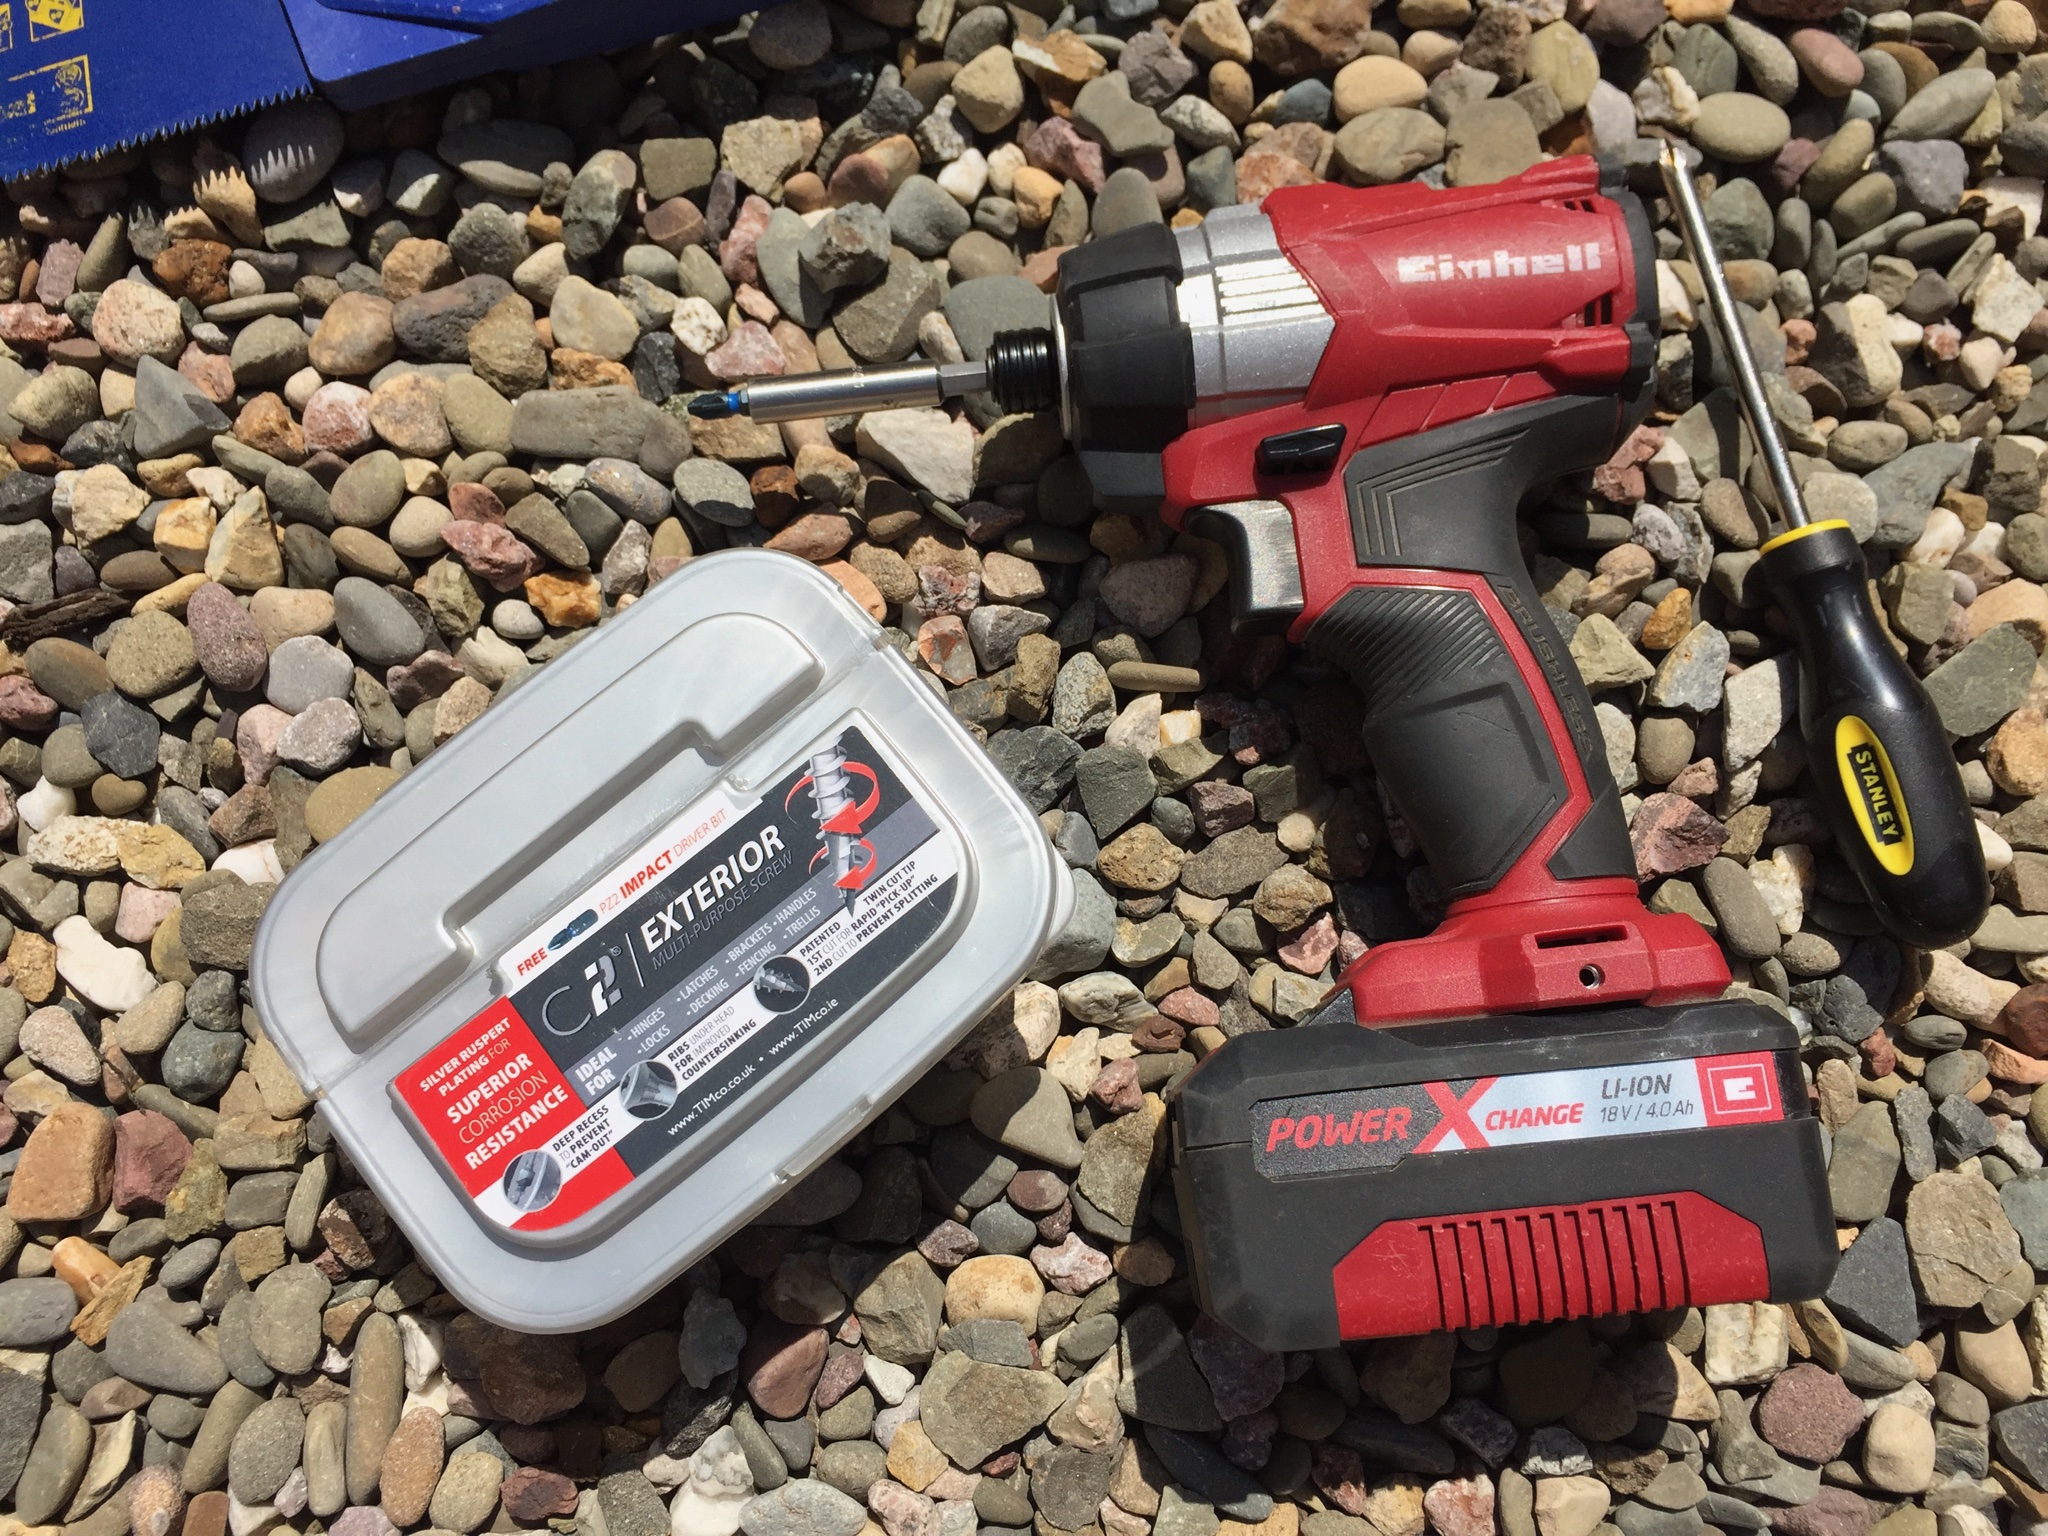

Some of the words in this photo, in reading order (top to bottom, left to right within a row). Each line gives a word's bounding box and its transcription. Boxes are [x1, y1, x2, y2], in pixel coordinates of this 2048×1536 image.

[1397, 242, 1602, 283] Einhell
[1855, 750, 1899, 837] STANLEY
[598, 892, 620, 914] PZ2
[619, 849, 671, 898] IMPACT
[672, 822, 710, 857] DRIVER
[709, 807, 726, 828] BIT
[640, 824, 785, 953] EXTERIOR
[652, 884, 750, 969] MULTI-PURPOSE
[749, 849, 792, 892] SCREW
[799, 921, 840, 957] PATENTED
[862, 884, 887, 905] TWIN
[886, 871, 902, 887] CUT
[900, 860, 915, 874] TIP
[806, 949, 822, 965] 1ST
[821, 938, 837, 954] CUT
[835, 927, 852, 942] FOR
[850, 907, 877, 931] RAPID
[813, 957, 832, 976] 2ND
[832, 945, 847, 961] CUT
[845, 938, 857, 949] TO
[855, 907, 894, 942] PREVENT
[893, 873, 938, 912] SPLITTING
[516, 947, 547, 976] FREE
[630, 1007, 665, 1037] HINGES
[679, 964, 718, 999] LATCHES
[727, 922, 772, 961] BRACKETS
[775, 887, 816, 923] HANDLES
[640, 1024, 670, 1051] LOCKS
[689, 978, 729, 1013] DECKING
[737, 940, 776, 974] FENCING
[784, 905, 820, 936] TRELLIS
[419, 1056, 461, 1091] SILVER
[458, 1017, 510, 1061] RUSPERT
[574, 1046, 617, 1082] IDEAL
[667, 1041, 690, 1061] RIBS
[688, 1021, 715, 1044] UNDER
[713, 1005, 734, 1025] HEAD
[674, 1053, 694, 1071] FOR
[691, 1024, 730, 1057] IMPROVED
[681, 1018, 756, 1080] COUNTERSINKING
[438, 1054, 489, 1096] PLATING
[487, 1037, 511, 1059] FOR
[446, 1052, 533, 1123] SUPERIOR
[584, 1068, 615, 1095] FOR
[667, 1064, 756, 1135] www.TIMco.co.uk
[768, 998, 838, 1054] www.TIMco.ie
[1600, 1074, 1672, 1100] LI-ION
[459, 1069, 548, 1143] CORROSION
[464, 1084, 568, 1169] RESISTANCE
[552, 1129, 575, 1151] DEEP
[575, 1104, 608, 1133] RECESS
[1265, 1106, 1412, 1153] POWER
[1485, 1102, 1584, 1131] CHANGE
[558, 1149, 570, 1161] TO
[569, 1118, 609, 1153] PREVENT
